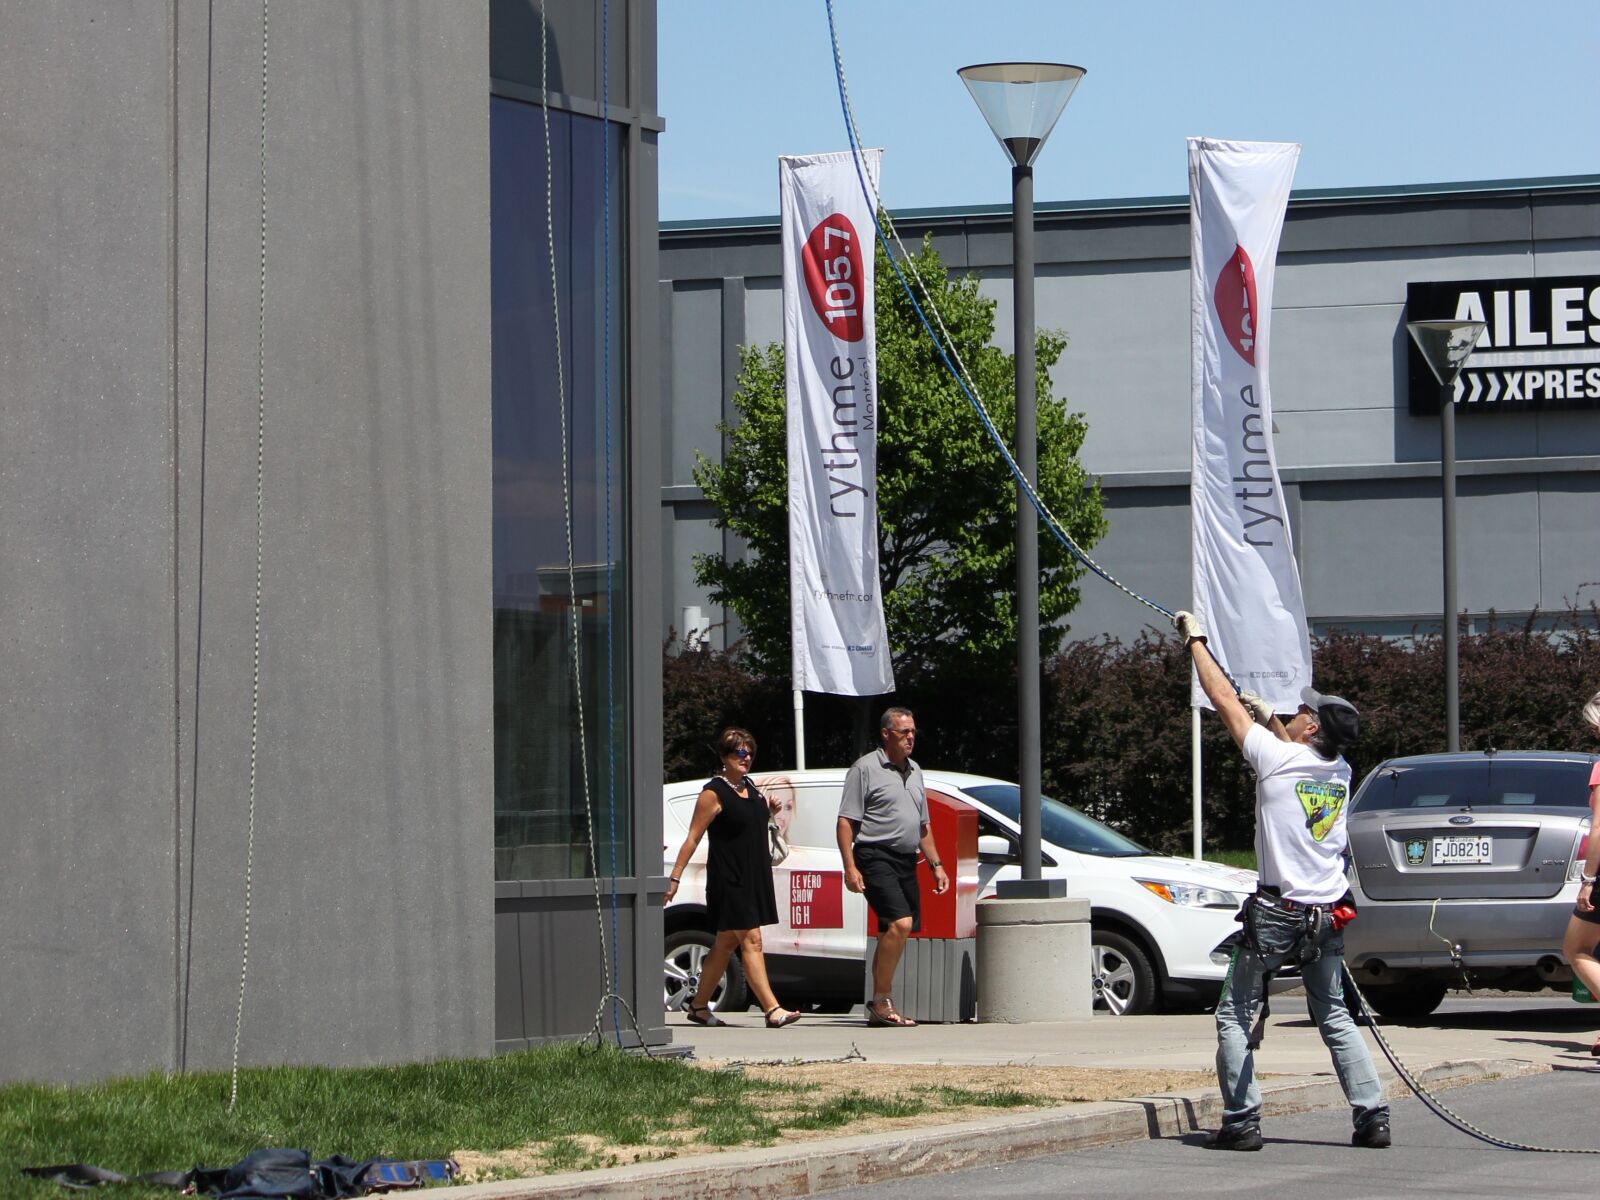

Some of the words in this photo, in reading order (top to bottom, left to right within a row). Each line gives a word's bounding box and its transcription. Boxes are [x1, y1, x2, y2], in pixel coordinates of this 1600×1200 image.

[824, 226, 857, 324] 105.7
[821, 355, 869, 518] rythme
[1232, 384, 1284, 547] rythme
[1434, 842, 1489, 858] FJD8219
[792, 874, 801, 889] LE
[803, 872, 822, 889] VÉRO
[792, 889, 814, 903] SHOW
[792, 905, 802, 925] 16
[803, 905, 810, 925] H
